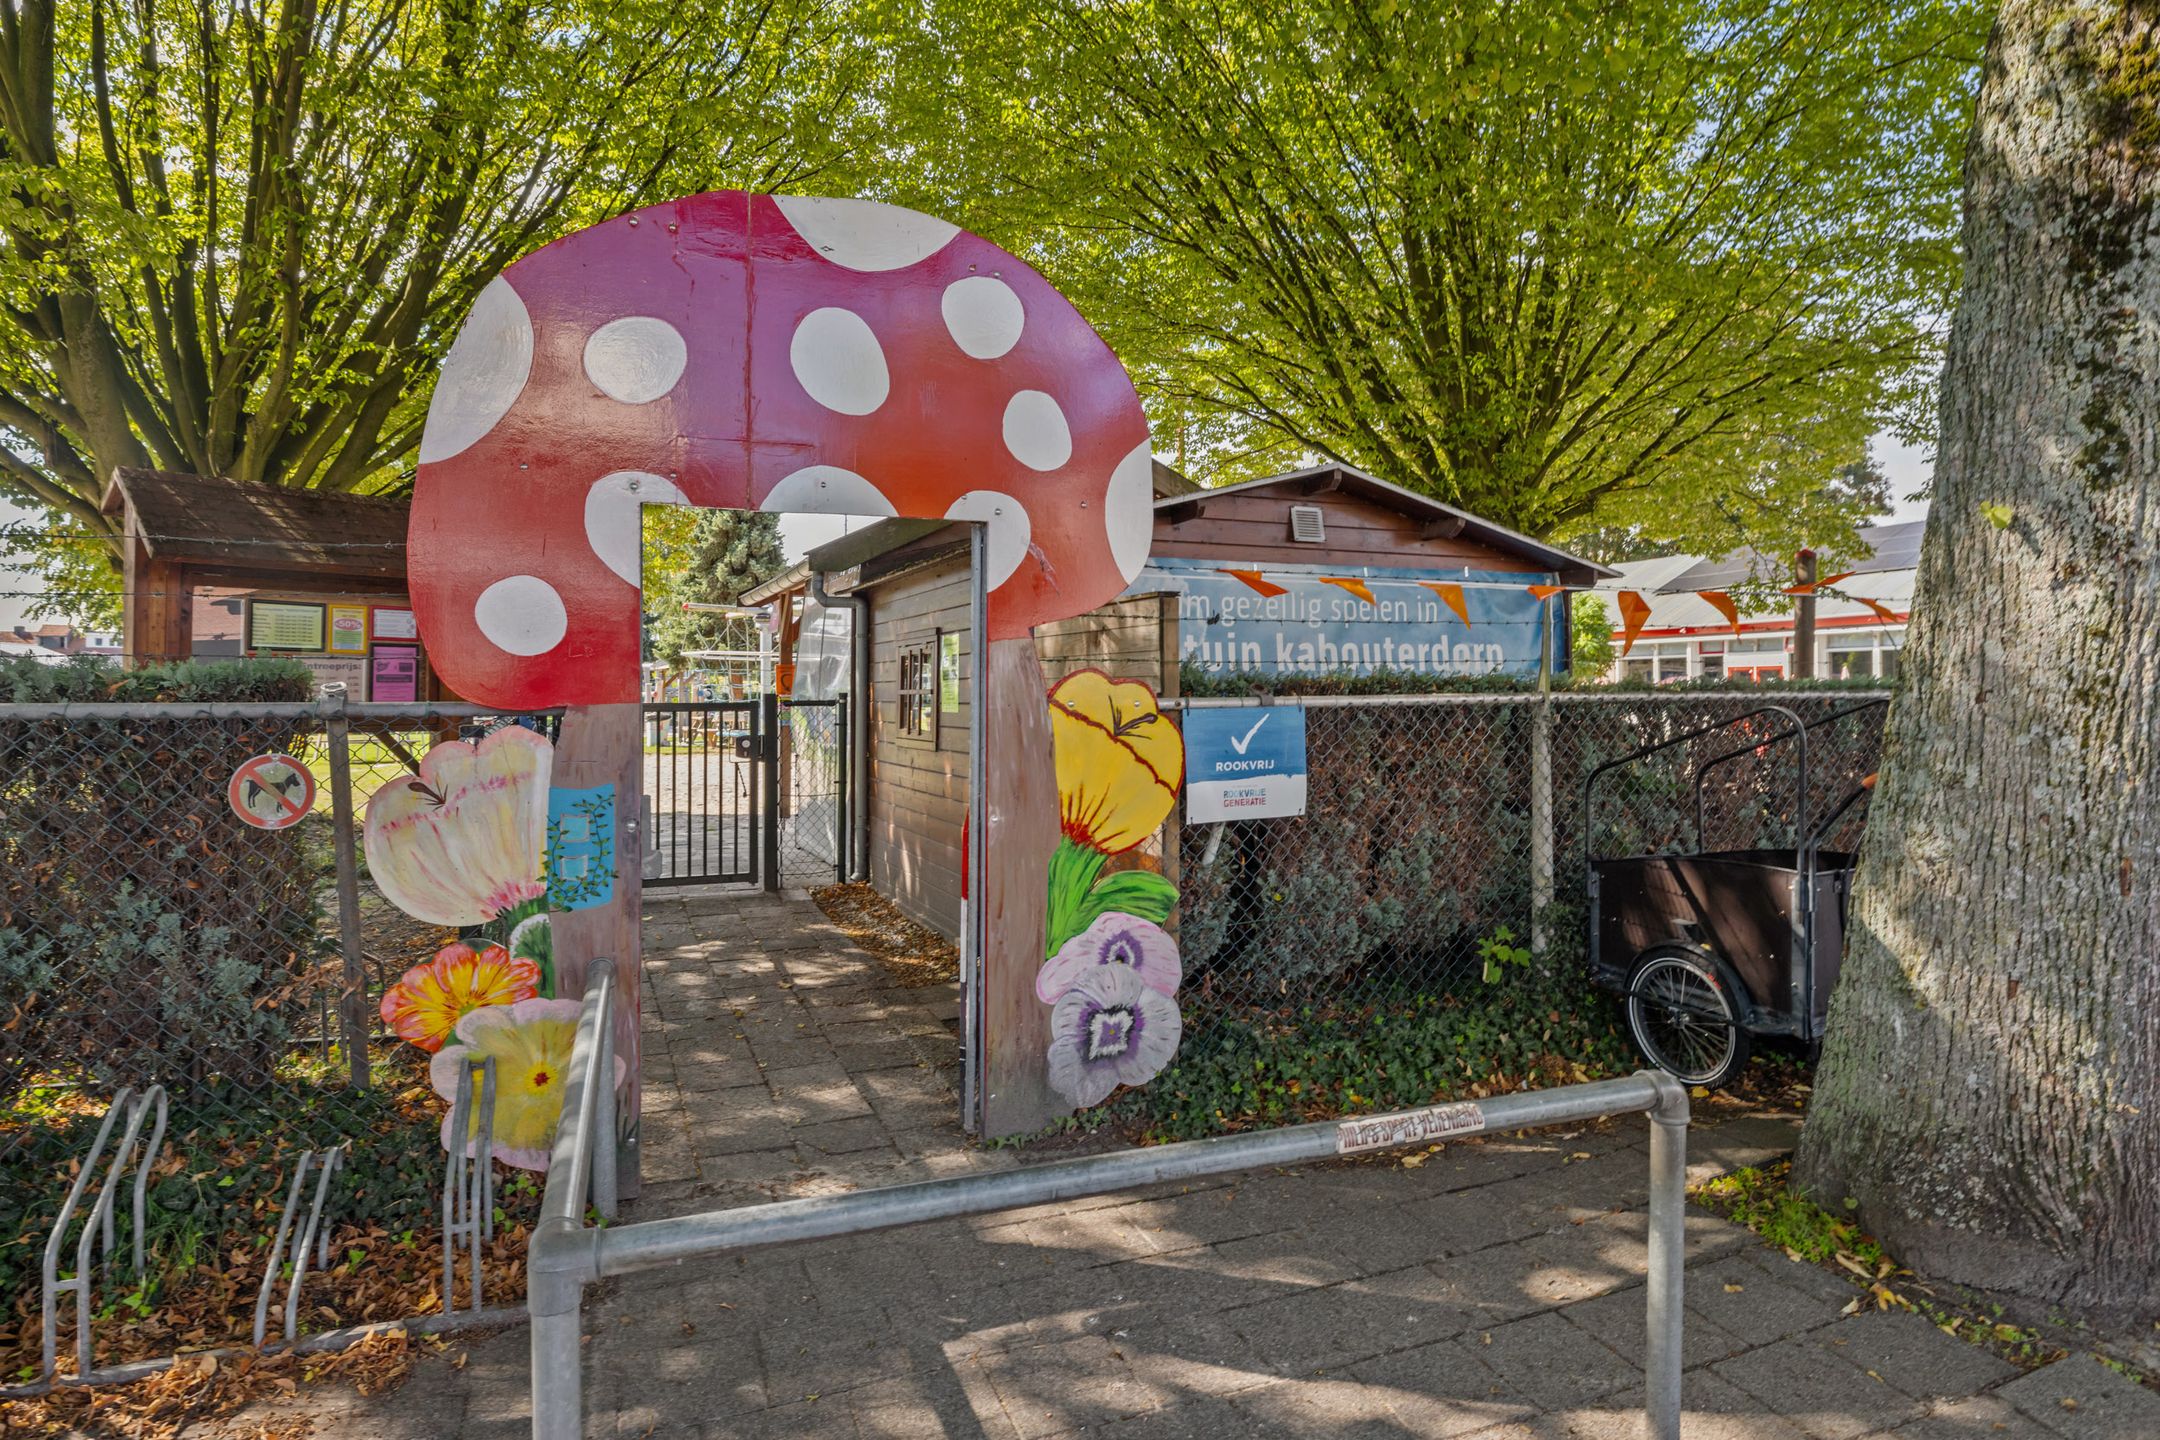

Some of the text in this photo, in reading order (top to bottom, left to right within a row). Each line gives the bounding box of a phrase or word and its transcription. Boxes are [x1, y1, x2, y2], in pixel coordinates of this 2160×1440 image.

[1221, 591, 1321, 628] gezellig
[1331, 594, 1407, 629] spelen
[1417, 595, 1438, 622] in
[1215, 760, 1275, 772] ROOKVRIJ
[1223, 797, 1267, 807] GENERATIE
